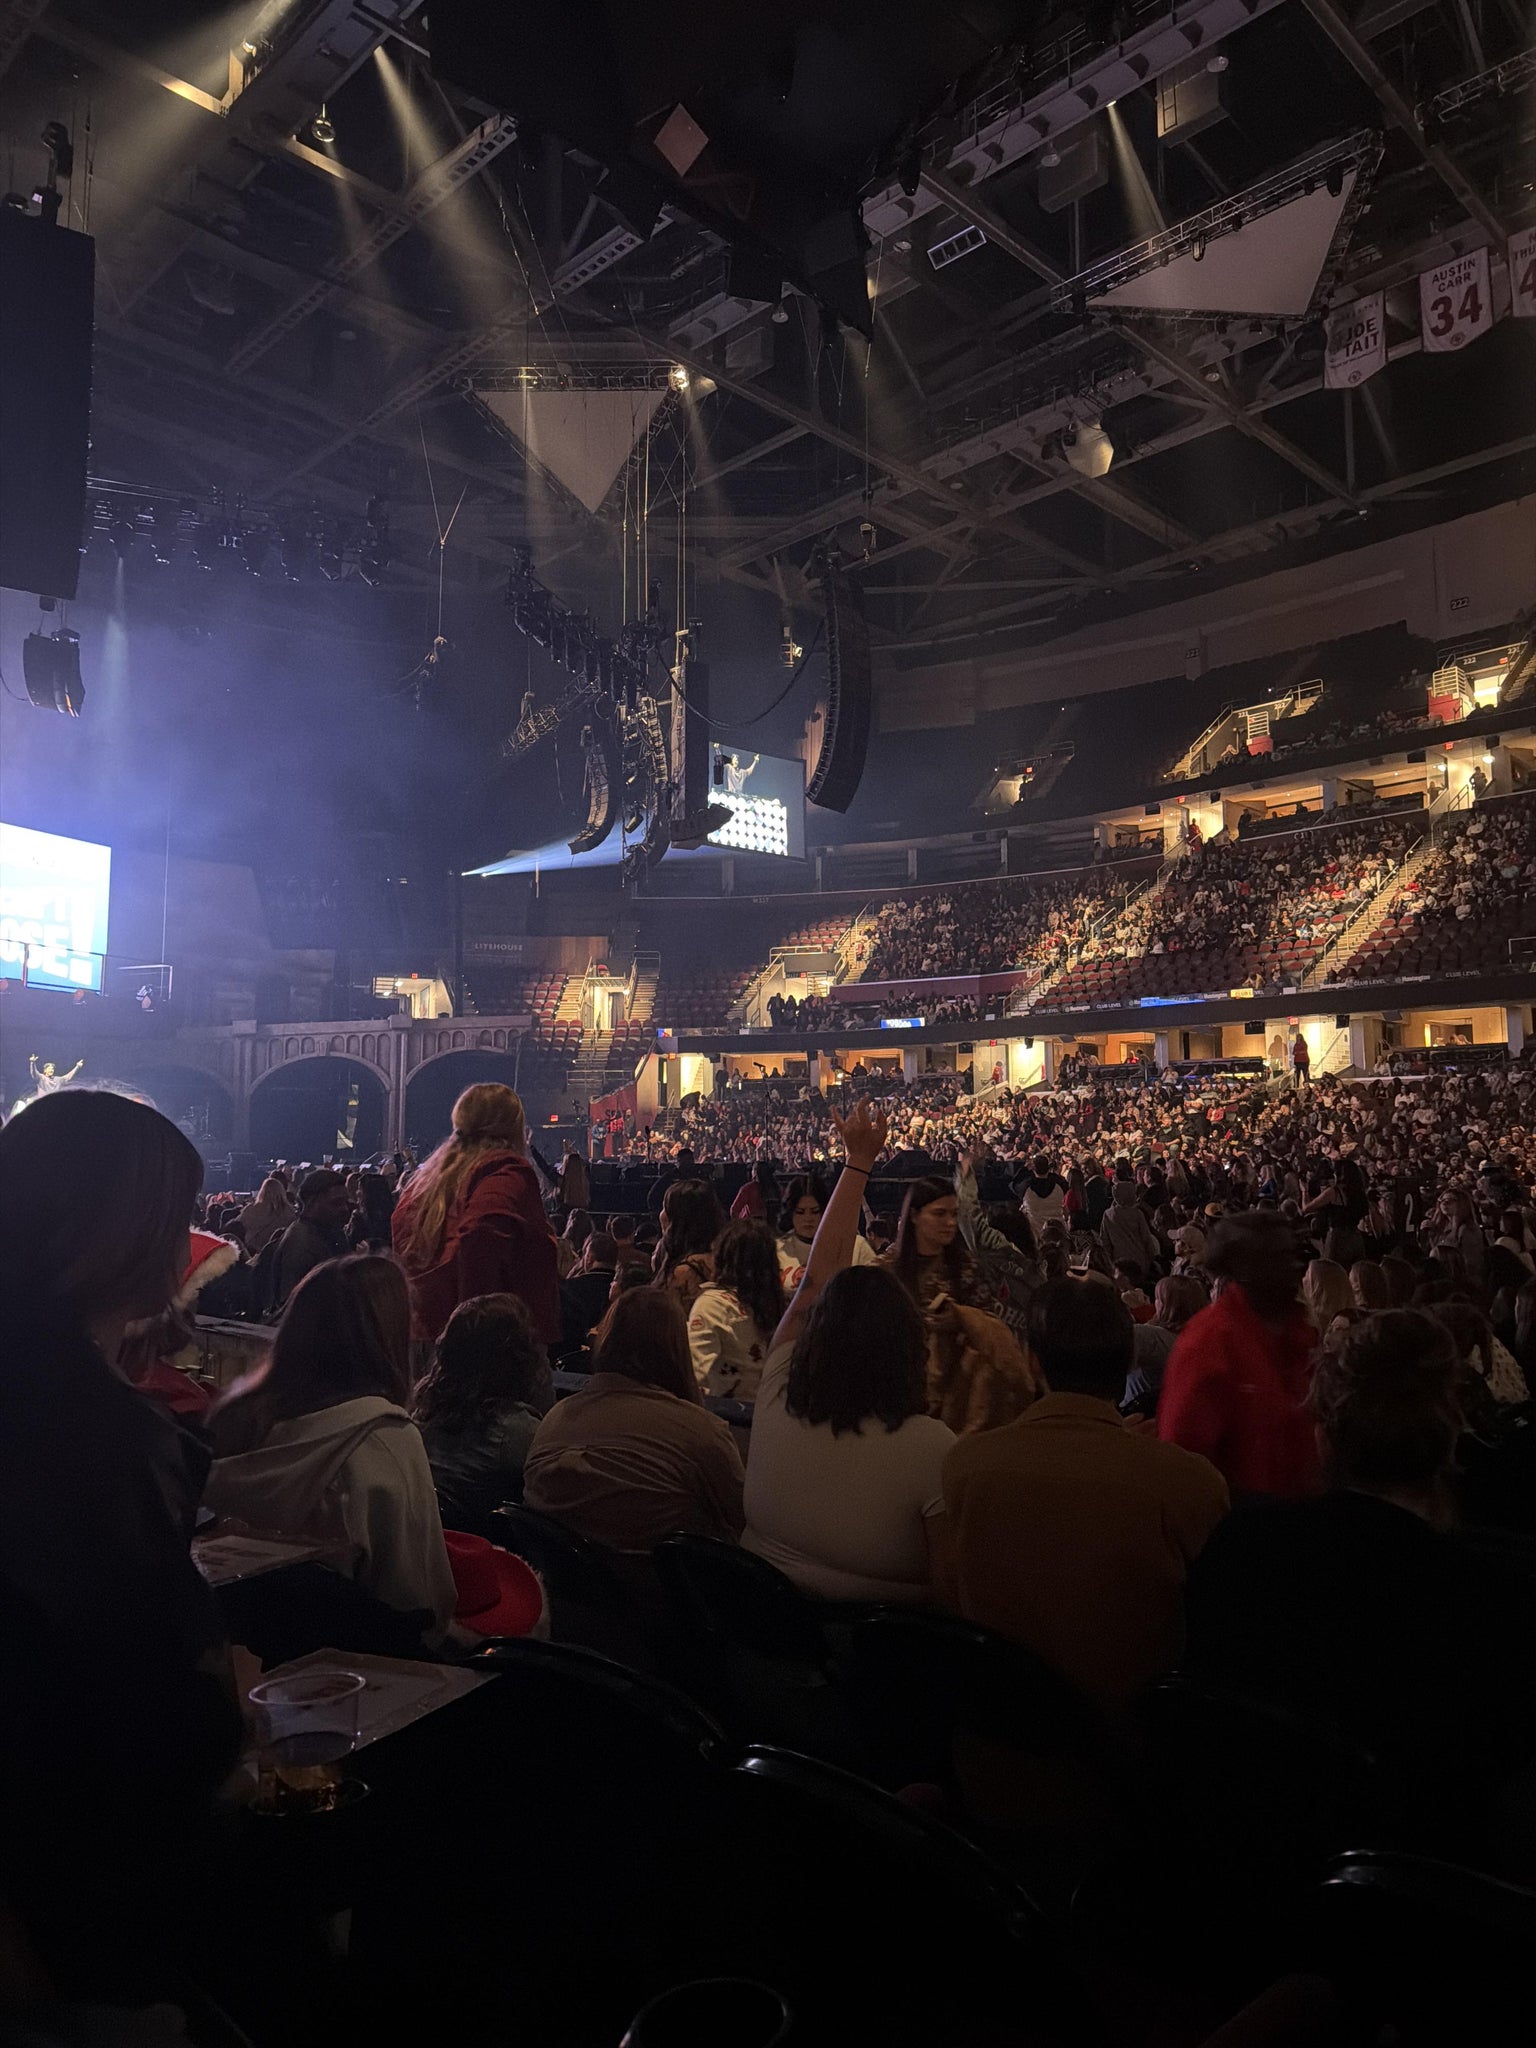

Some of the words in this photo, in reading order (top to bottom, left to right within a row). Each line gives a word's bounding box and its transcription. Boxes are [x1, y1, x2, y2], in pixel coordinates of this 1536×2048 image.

[1432, 259, 1475, 284] AUSTIN
[1438, 272, 1471, 292] CARR
[1430, 282, 1482, 337] 34
[1347, 317, 1376, 341] JOE
[1344, 331, 1379, 357] TAIT
[1463, 657, 1476, 665] 222
[1404, 1193, 1414, 1232] 2
